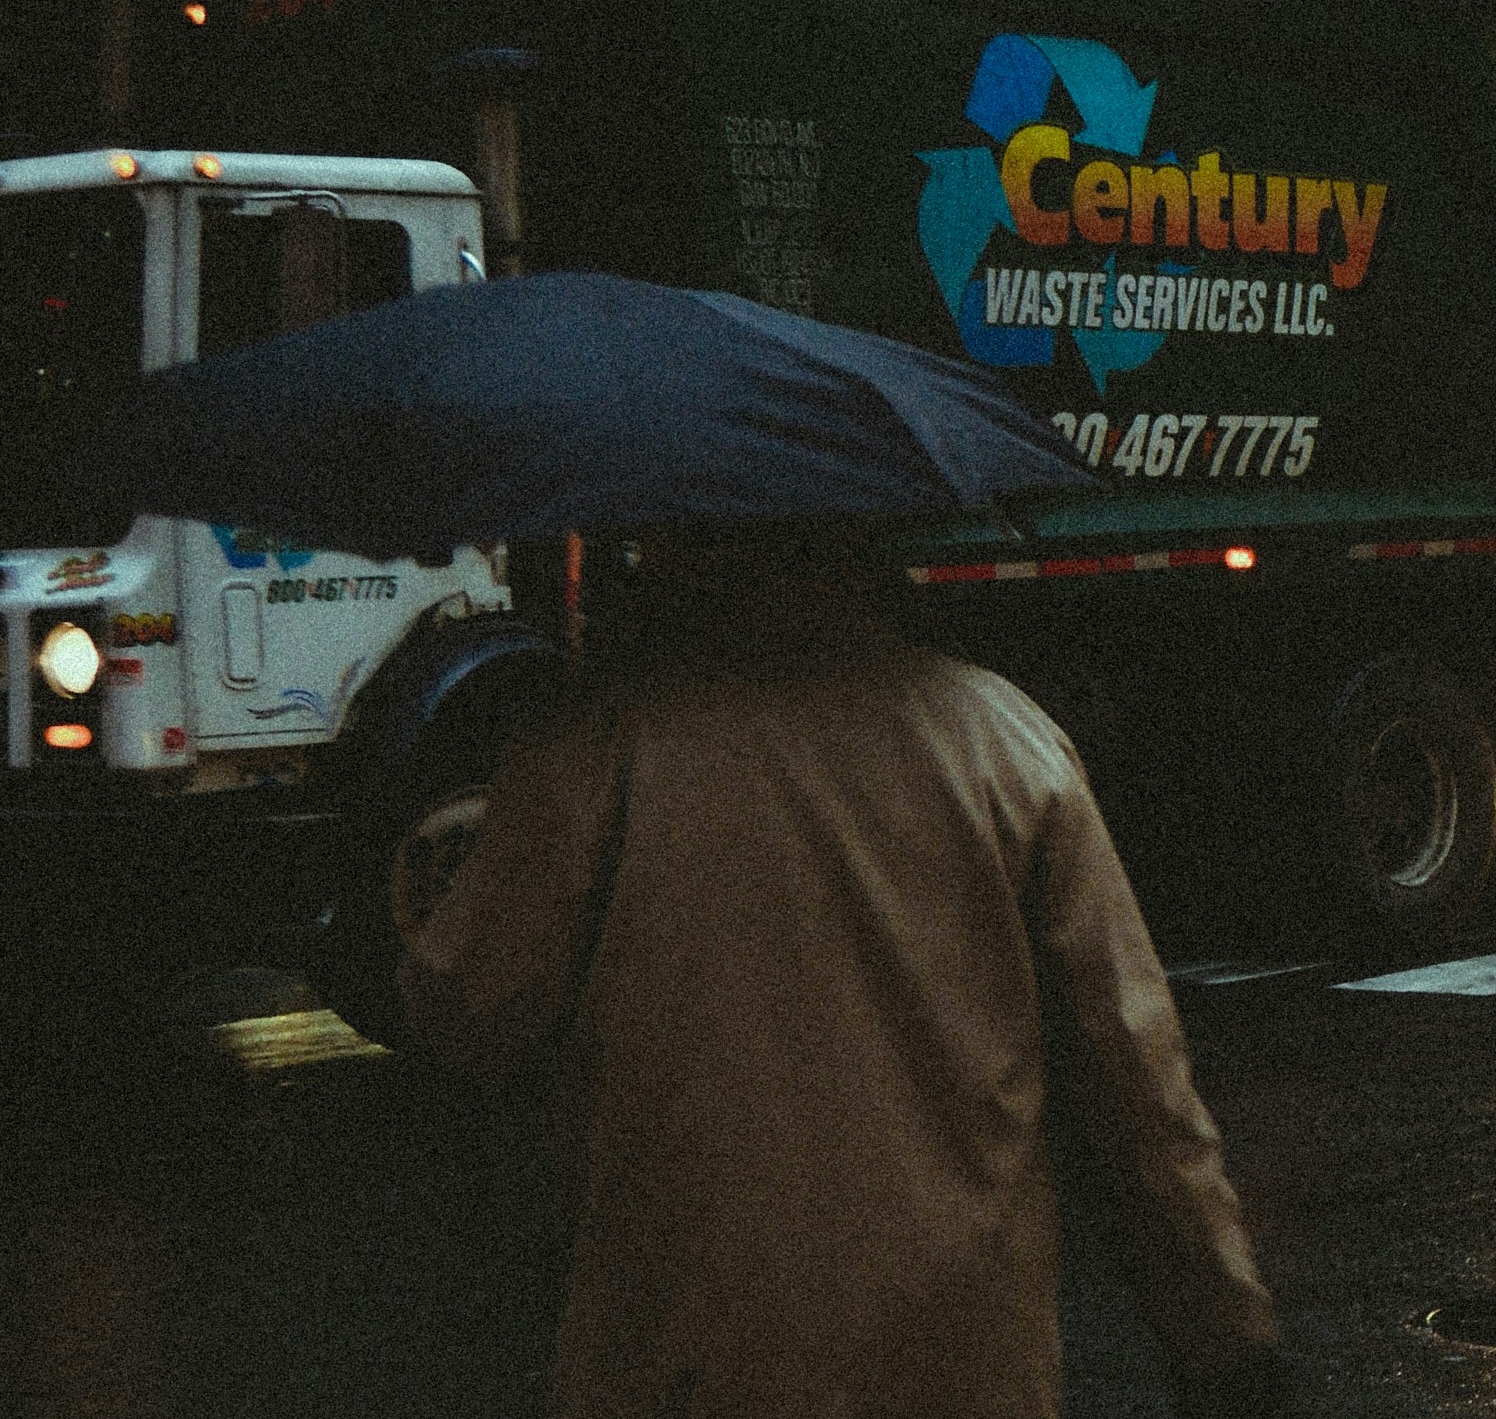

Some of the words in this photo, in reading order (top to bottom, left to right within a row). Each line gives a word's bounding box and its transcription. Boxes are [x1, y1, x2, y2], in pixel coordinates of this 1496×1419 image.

[1001, 123, 1388, 290] Century
[984, 267, 1105, 328] WASTE
[1113, 273, 1266, 335] SERVICES
[1272, 281, 1336, 336] LLC.
[1112, 413, 1208, 477] 467
[1208, 415, 1320, 478] 7775
